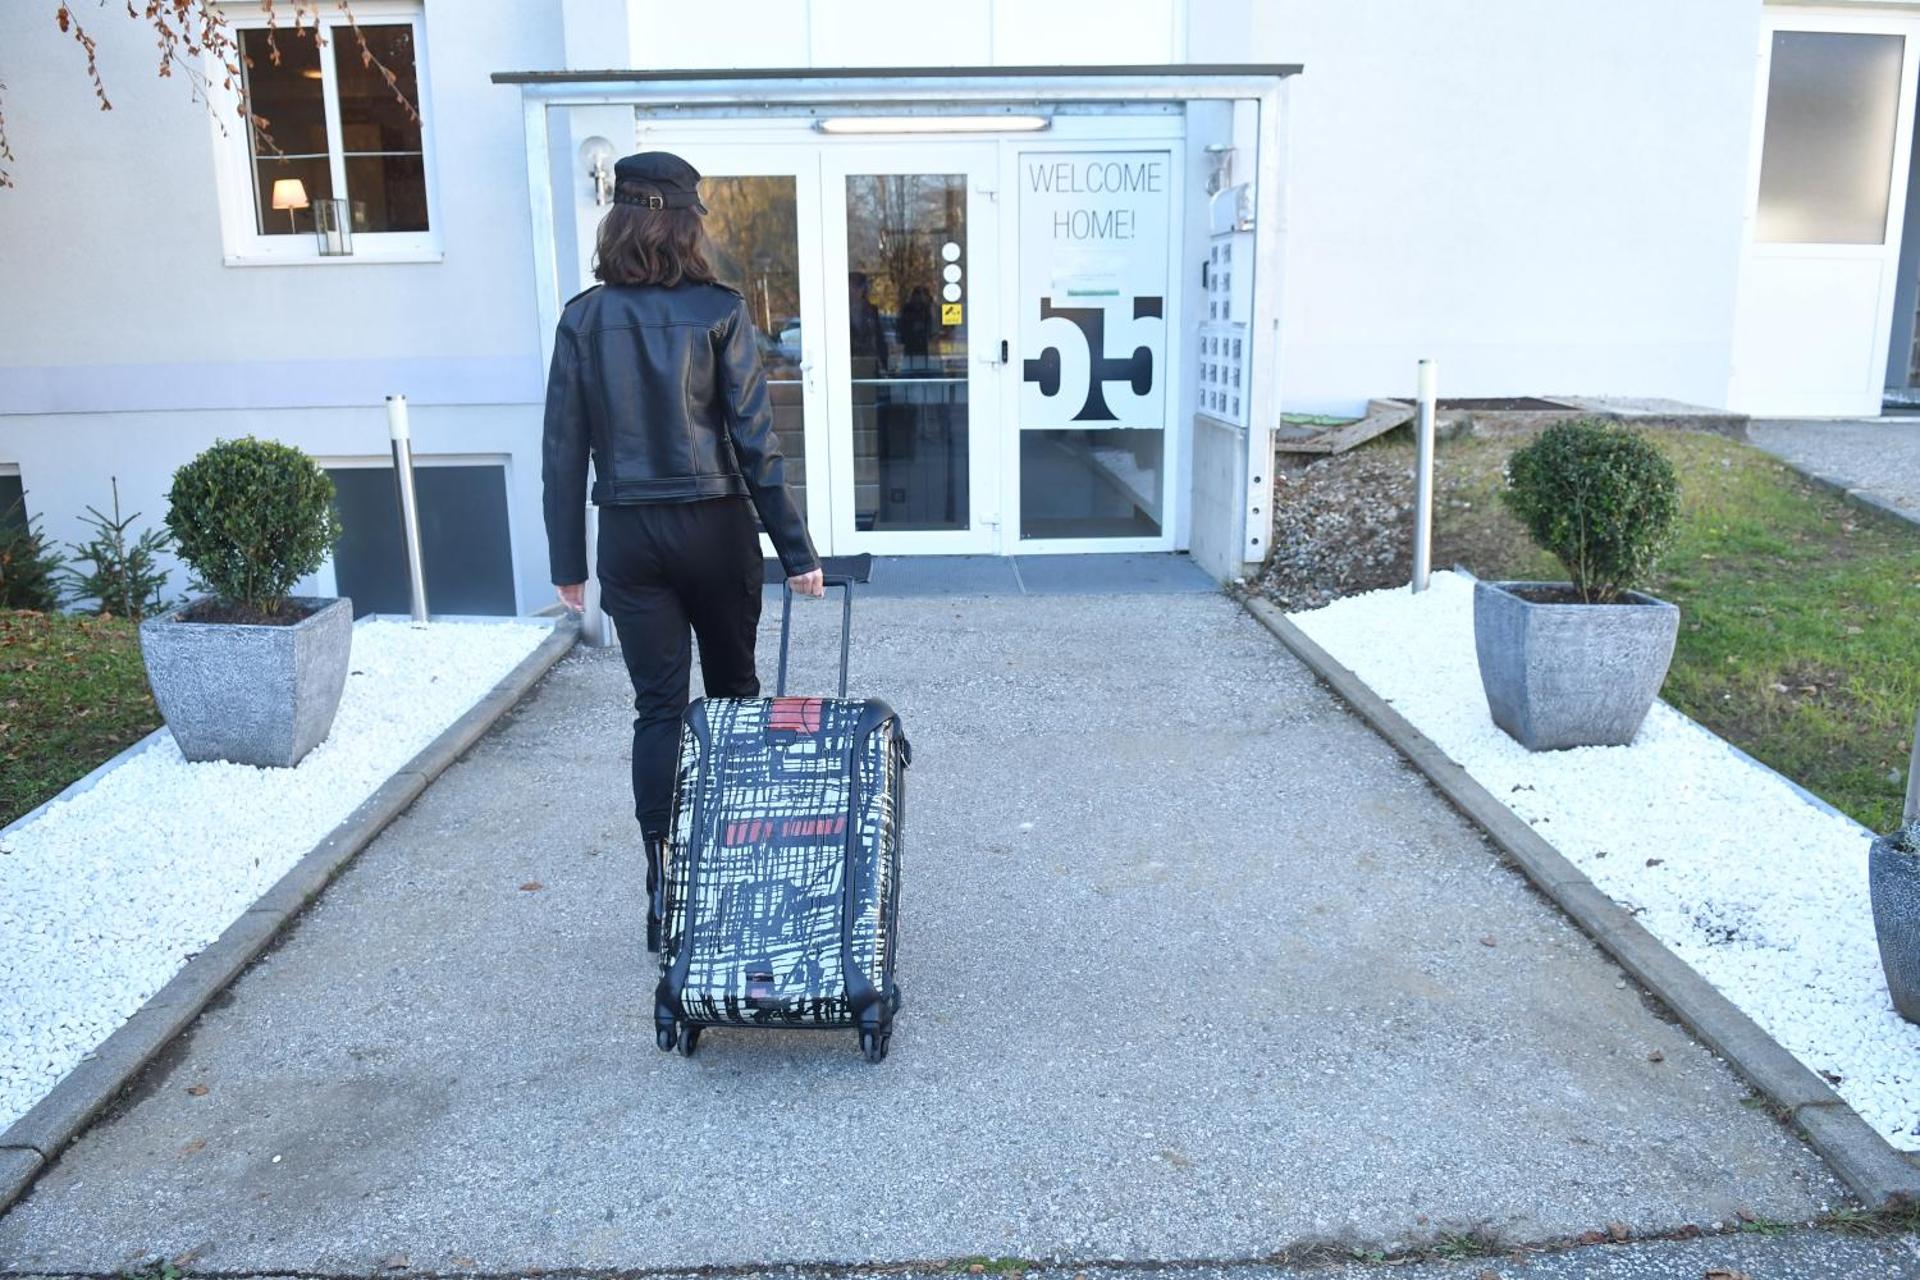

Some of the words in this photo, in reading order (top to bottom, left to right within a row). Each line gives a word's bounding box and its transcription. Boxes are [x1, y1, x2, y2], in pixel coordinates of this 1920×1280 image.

[1029, 163, 1163, 193] WELCOME
[1053, 209, 1136, 238] HOME!
[1023, 296, 1163, 421] 55
